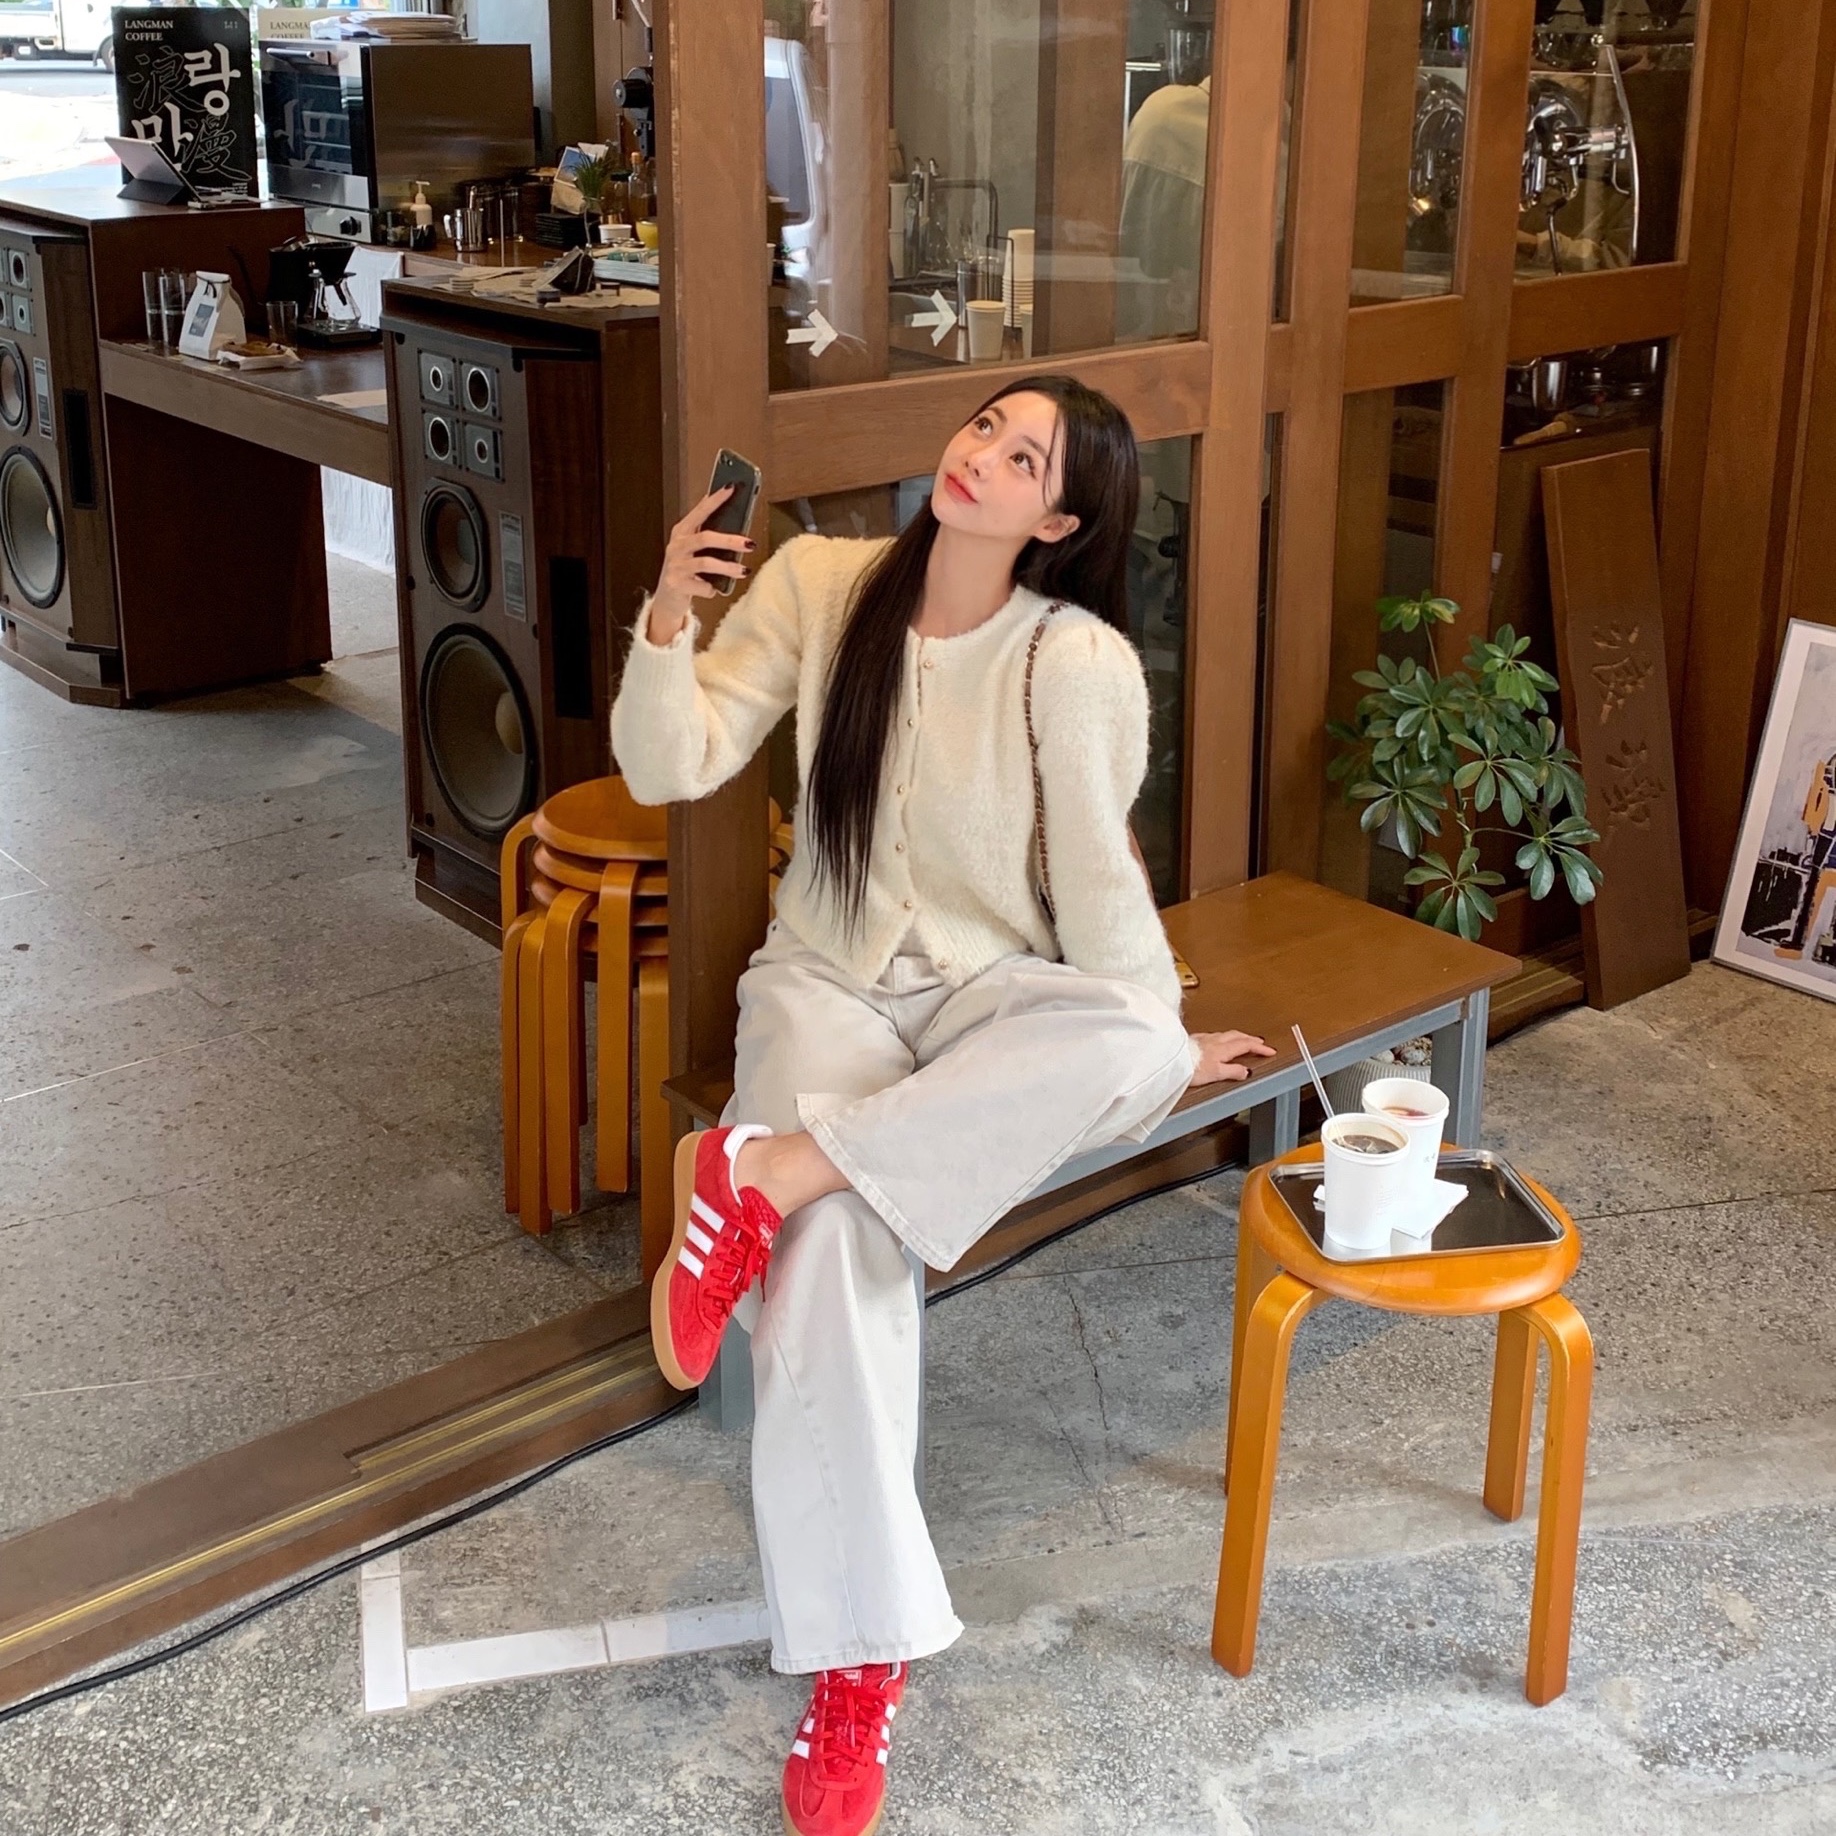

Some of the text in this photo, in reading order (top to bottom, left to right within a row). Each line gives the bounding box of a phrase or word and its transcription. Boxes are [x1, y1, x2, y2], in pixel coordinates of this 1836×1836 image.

[124, 19, 174, 30] LANGMAN
[269, 21, 310, 31] LANGMA
[124, 32, 164, 42] COFFEE
